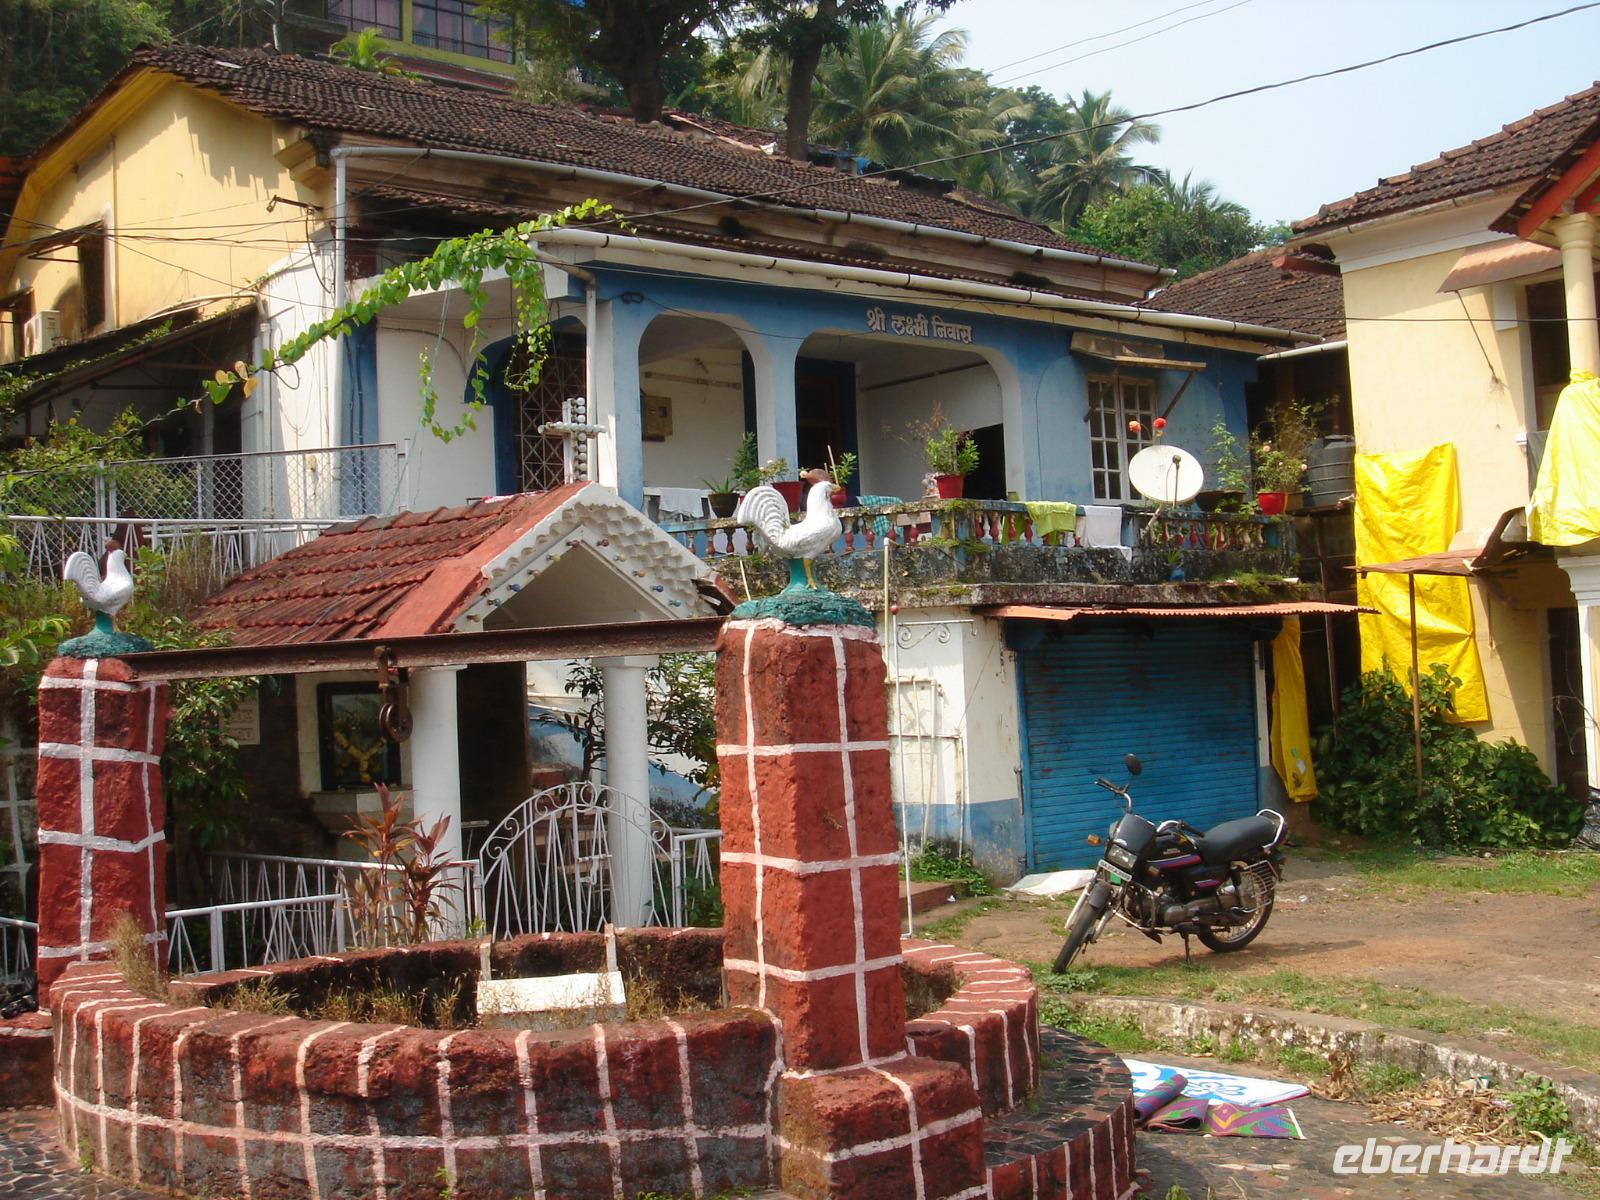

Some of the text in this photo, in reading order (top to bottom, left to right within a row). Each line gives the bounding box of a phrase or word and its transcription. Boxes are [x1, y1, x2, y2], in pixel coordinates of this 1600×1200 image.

[866, 306, 972, 343] श्री लक्ष्मी निवास
